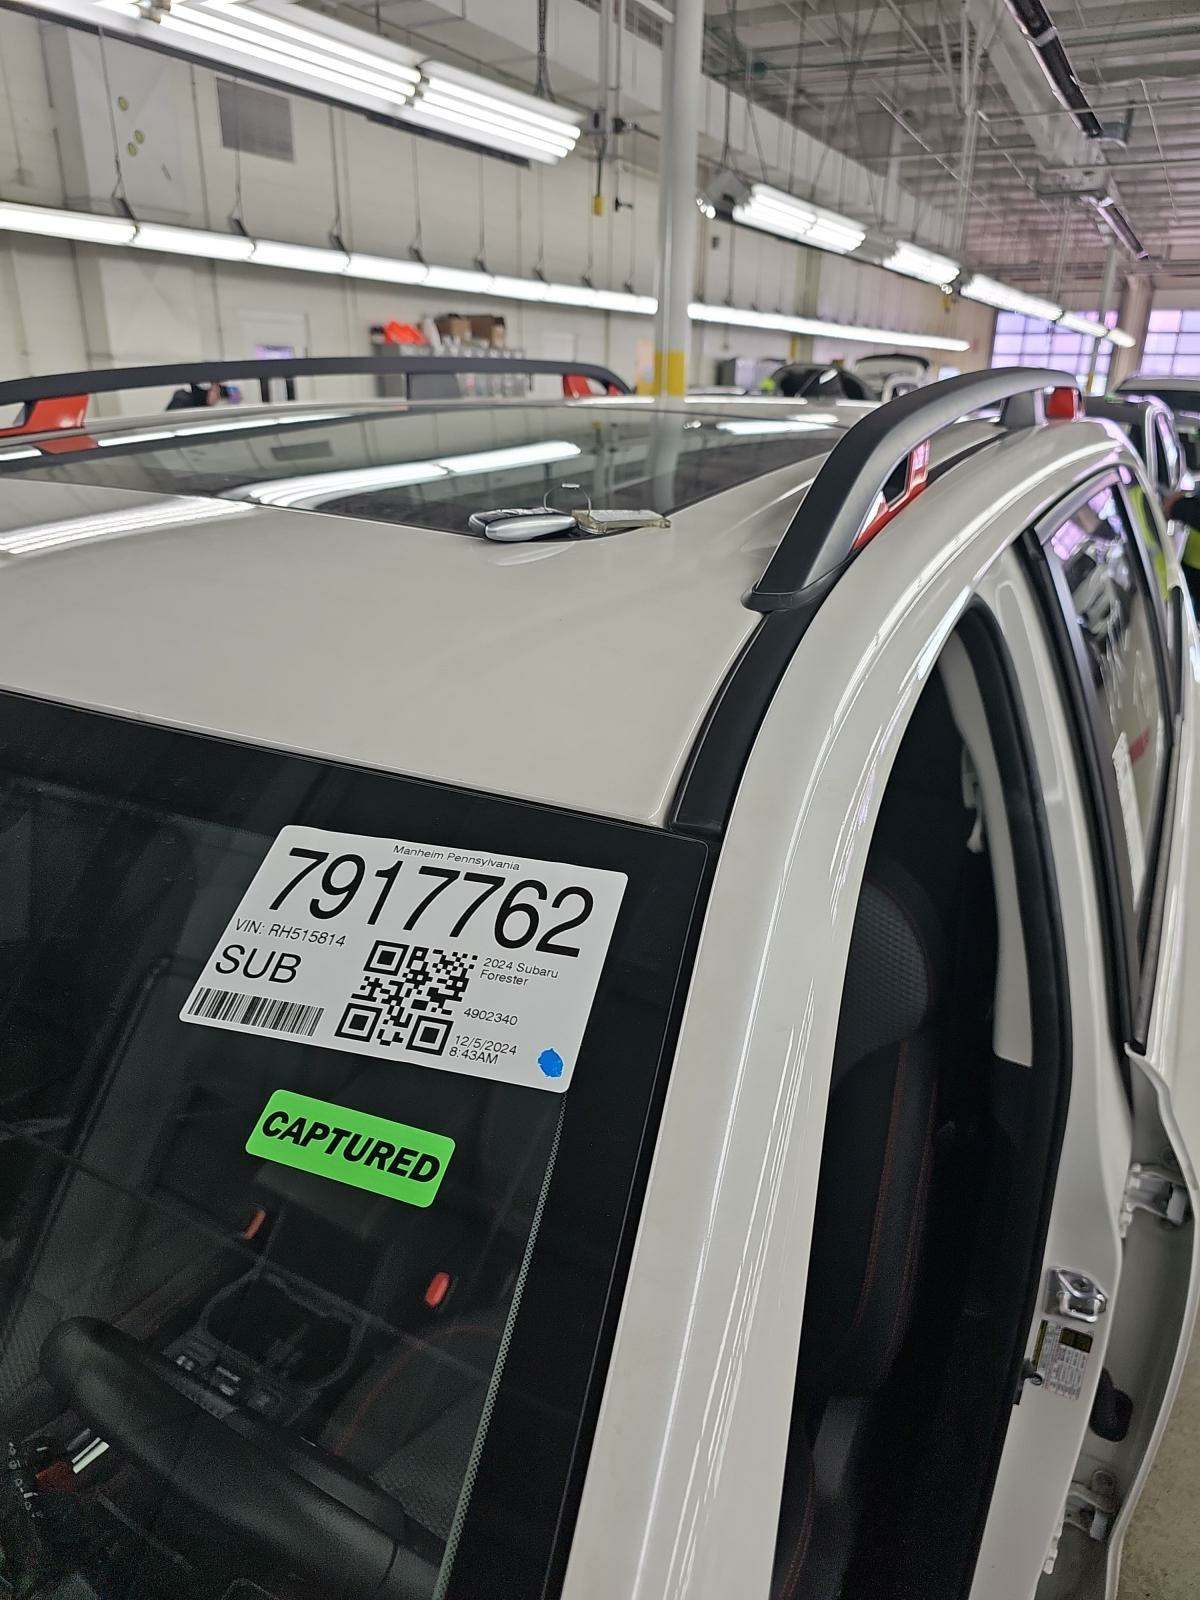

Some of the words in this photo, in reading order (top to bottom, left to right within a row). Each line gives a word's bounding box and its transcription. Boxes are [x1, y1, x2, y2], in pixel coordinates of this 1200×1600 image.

[393, 844, 444, 860] Manheim
[446, 852, 521, 871] Pennsylvania
[269, 847, 594, 958] 7917762
[235, 918, 265, 935] VIN:
[267, 923, 347, 947] RH515814
[215, 944, 302, 984] SUB
[483, 957, 514, 971] 2024
[516, 962, 559, 979] Subaru
[480, 969, 529, 986] Forester
[463, 1007, 518, 1026] 4902340
[448, 1046, 499, 1065] 8:43AM
[454, 1035, 518, 1056] 12/5/2024
[262, 1110, 440, 1183] CAPTURED
